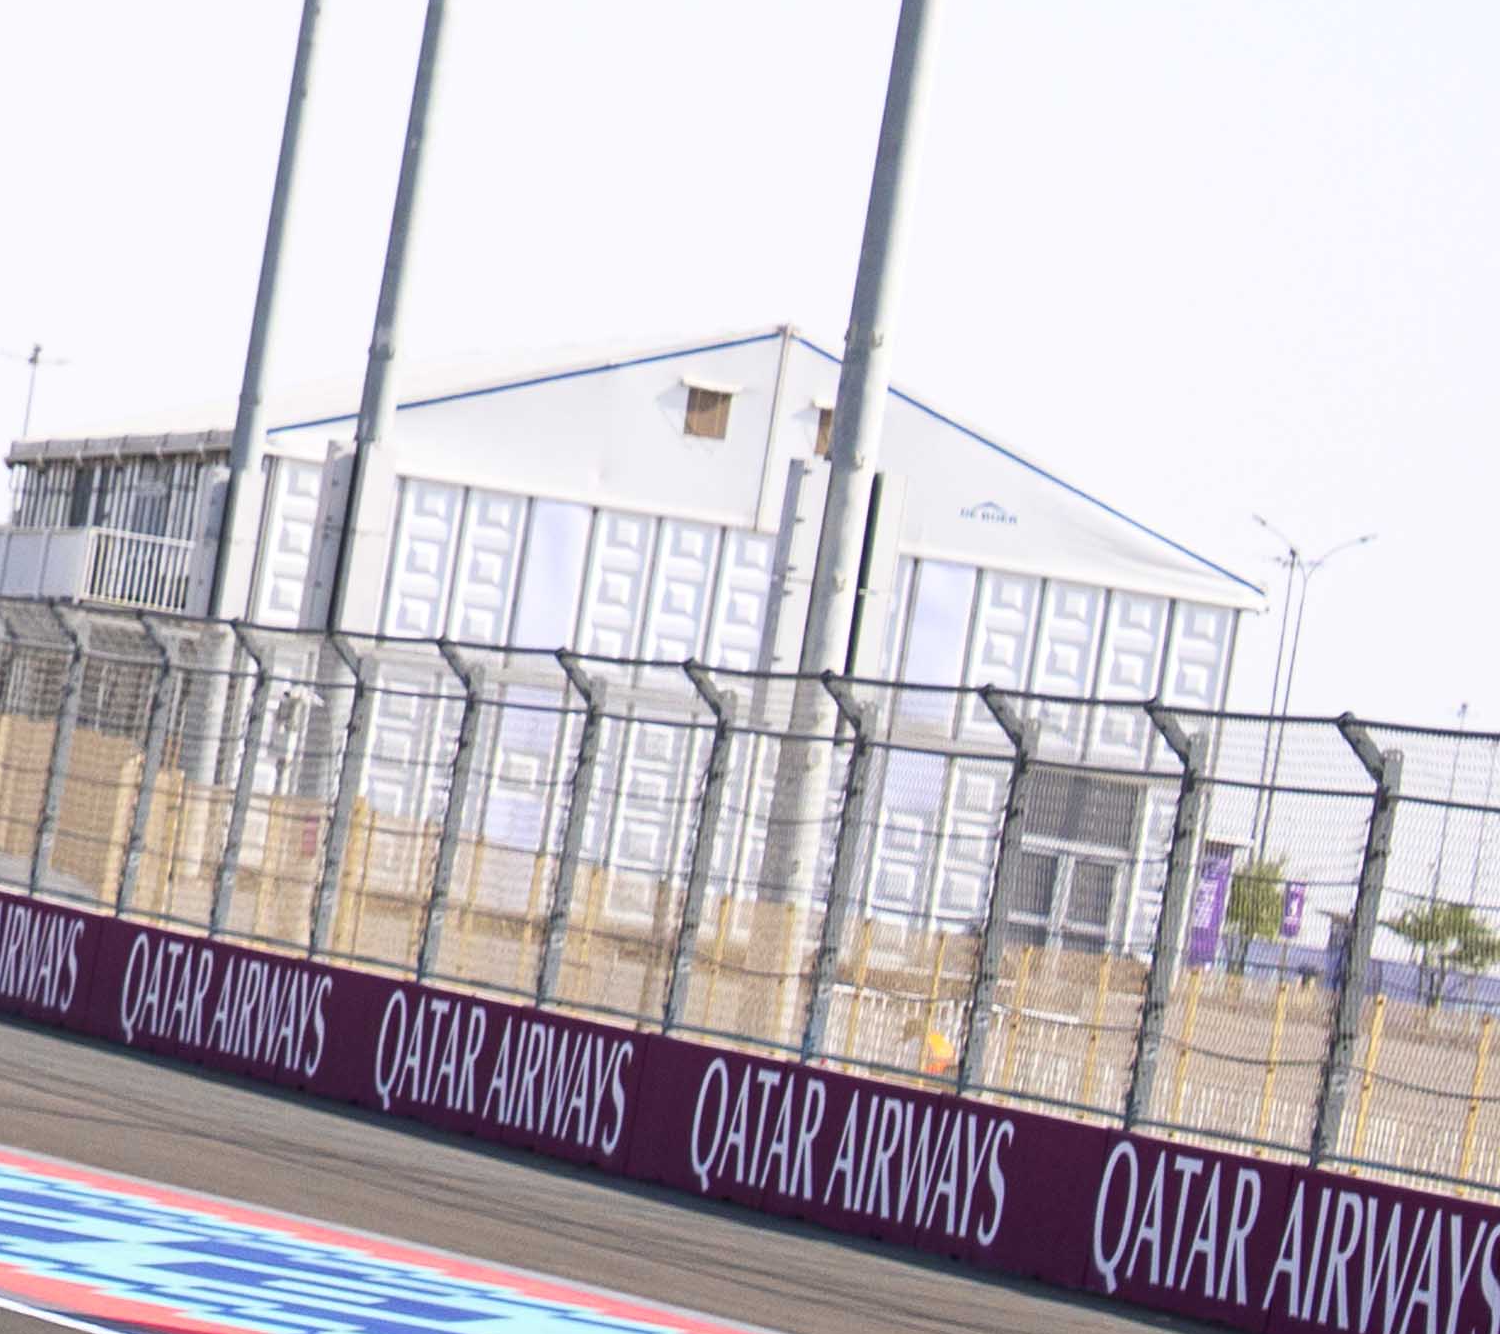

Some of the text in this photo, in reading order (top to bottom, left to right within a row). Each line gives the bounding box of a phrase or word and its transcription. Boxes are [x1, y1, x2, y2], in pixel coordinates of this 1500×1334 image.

[120, 932, 333, 1077] QATAR AIRWAYS
[374, 990, 635, 1156] QATAR AIRWAYS
[689, 1057, 1015, 1246] QATAR AIRWAYS
[1093, 1141, 1261, 1306] QATAR
